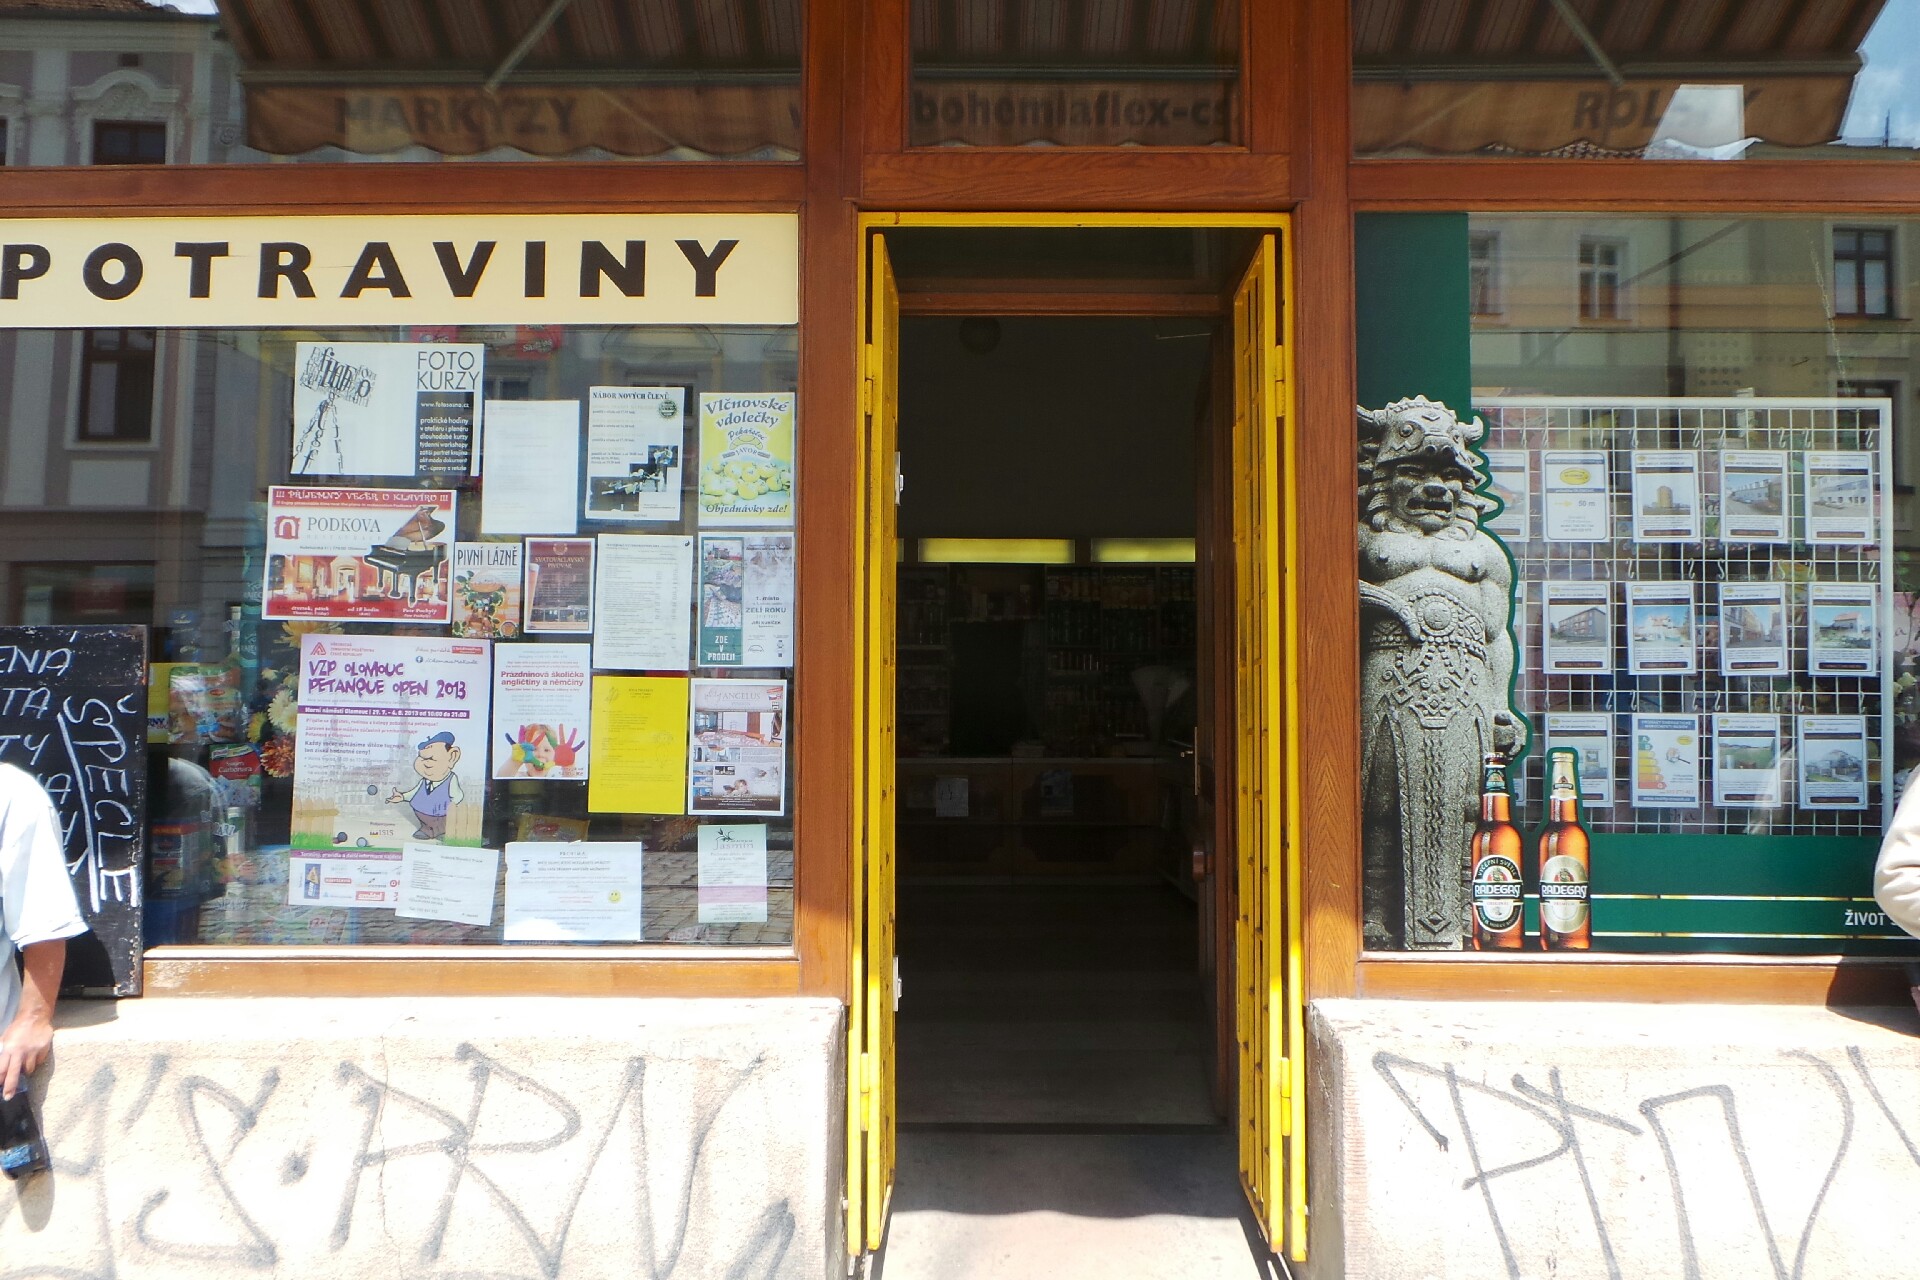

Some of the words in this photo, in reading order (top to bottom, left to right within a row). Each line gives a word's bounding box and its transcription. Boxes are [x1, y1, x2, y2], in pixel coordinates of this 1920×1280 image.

[1, 239, 740, 301] POTRAVINY
[417, 351, 475, 371] FOTO
[416, 371, 480, 390] KURZY
[618, 391, 646, 400] NOVÝCH
[705, 397, 790, 415] Vlčnovské
[716, 411, 779, 428] vdolečky
[735, 447, 758, 456] JAVOR
[706, 504, 766, 515] Objednávky
[767, 504, 788, 513] zde!
[307, 516, 381, 533] PODKOVA
[457, 546, 483, 566] PIVNÍ
[487, 546, 518, 566] LÁZNĚ
[714, 635, 729, 644] ZDE
[308, 659, 337, 677] VZP
[308, 677, 385, 698] PETANQUE
[392, 679, 429, 697] OPEN
[435, 678, 467, 700] 2013
[501, 678, 541, 687] angličtiny
[549, 678, 584, 687] němčiny
[344, 707, 368, 715] Olomouc
[1474, 884, 1521, 898] RADEGAST
[1541, 884, 1588, 899] RADEGAST
[1844, 908, 1886, 926] ŽIVOT
